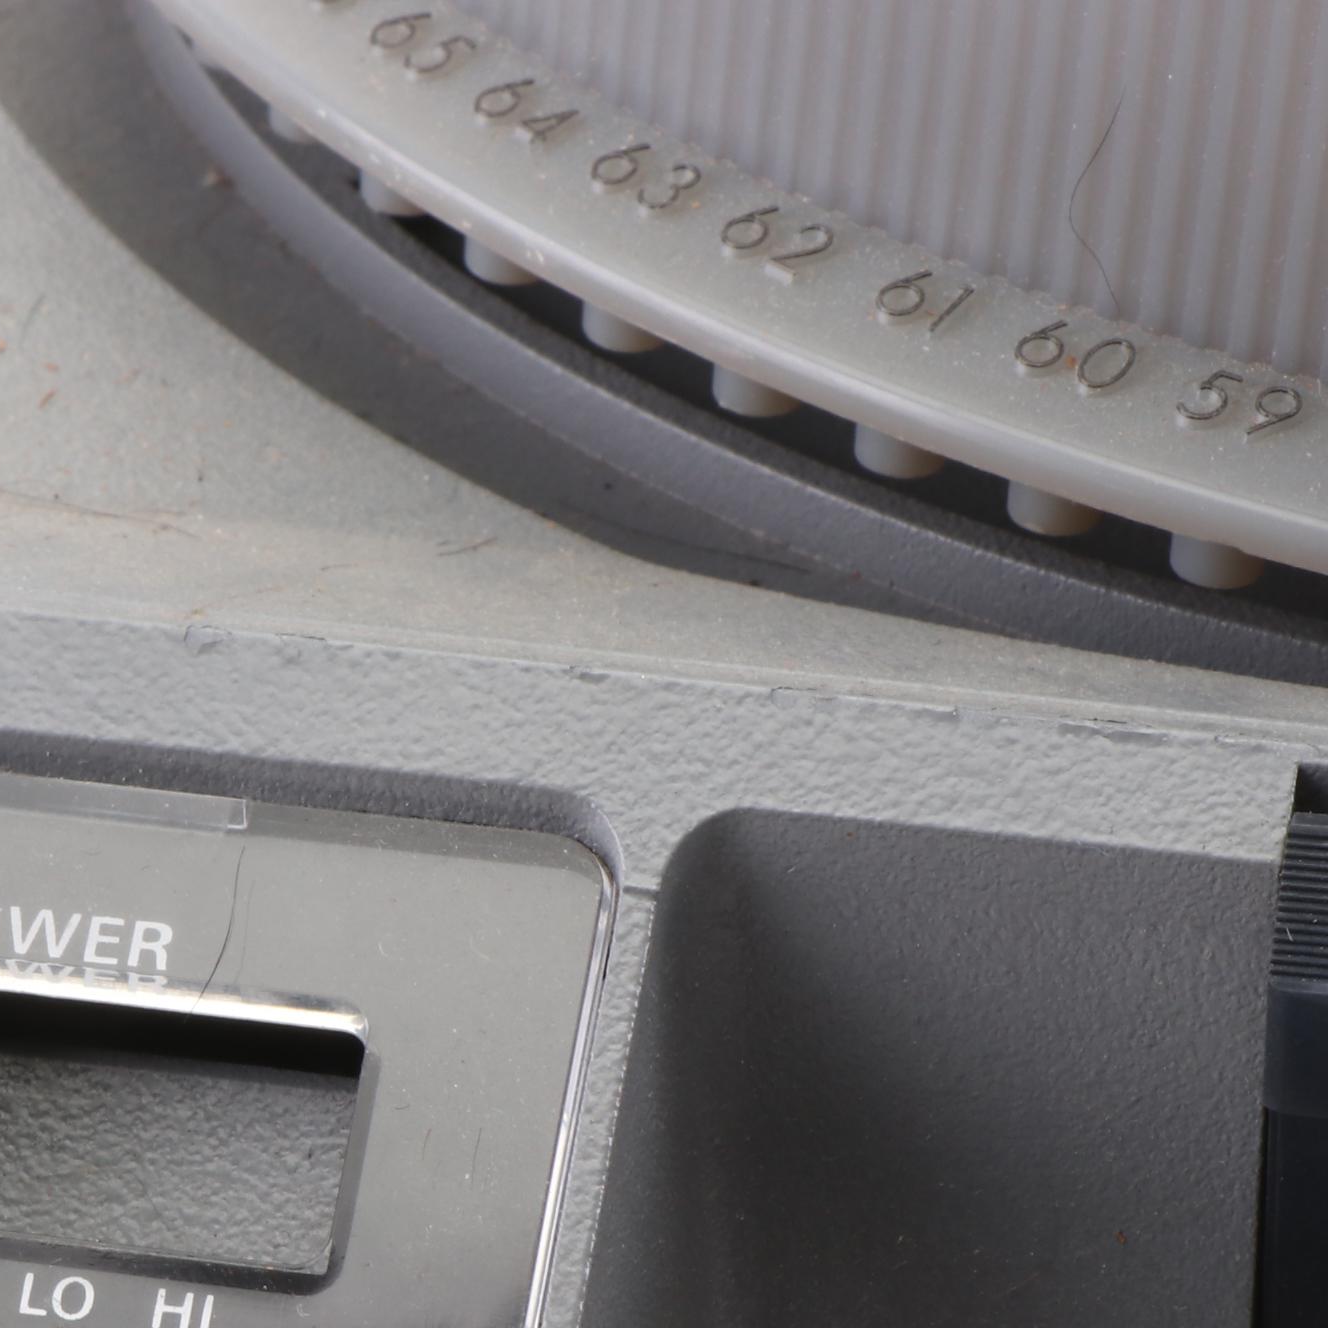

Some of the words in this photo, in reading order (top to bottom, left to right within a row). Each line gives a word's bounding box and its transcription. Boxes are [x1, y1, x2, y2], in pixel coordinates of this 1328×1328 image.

[370, 12, 477, 73] 65
[475, 79, 579, 144] 64
[591, 143, 702, 208] 63
[720, 206, 833, 277] 62
[876, 269, 974, 333] 61
[1014, 320, 1136, 389] 60
[1176, 370, 1303, 436] 59
[19, 1272, 95, 1321] LO
